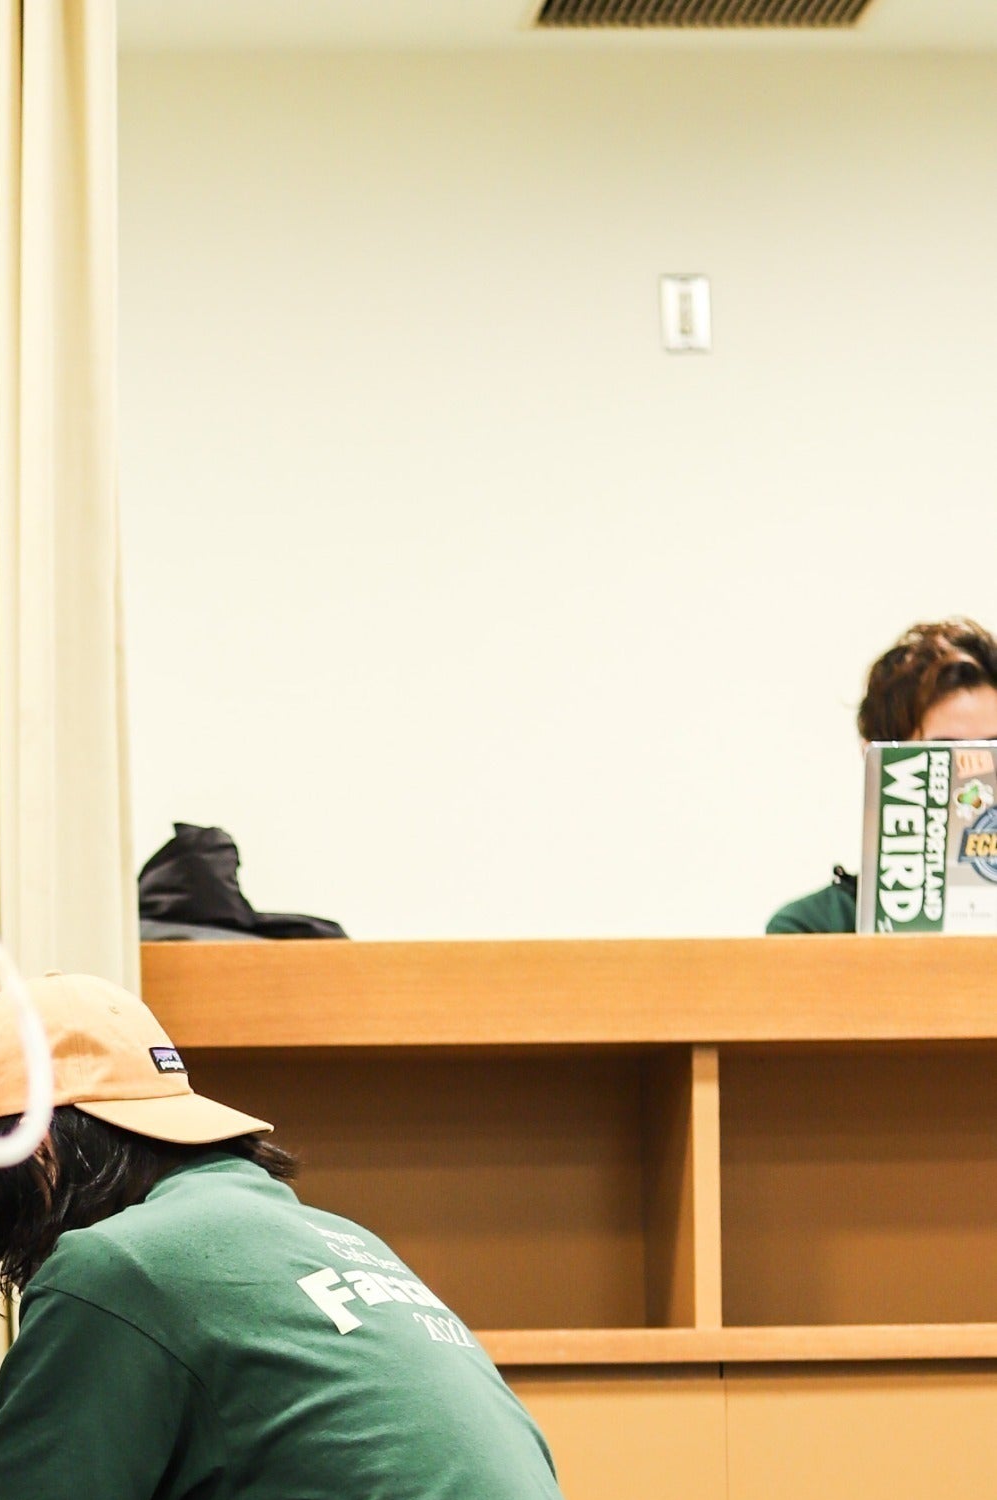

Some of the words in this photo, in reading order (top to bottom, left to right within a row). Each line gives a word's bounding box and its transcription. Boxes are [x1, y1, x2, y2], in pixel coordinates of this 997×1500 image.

[928, 751, 950, 805] KEEP
[879, 751, 928, 922] WEIRD
[923, 808, 947, 921] PORTLAND
[413, 1312, 476, 1348] 2022
